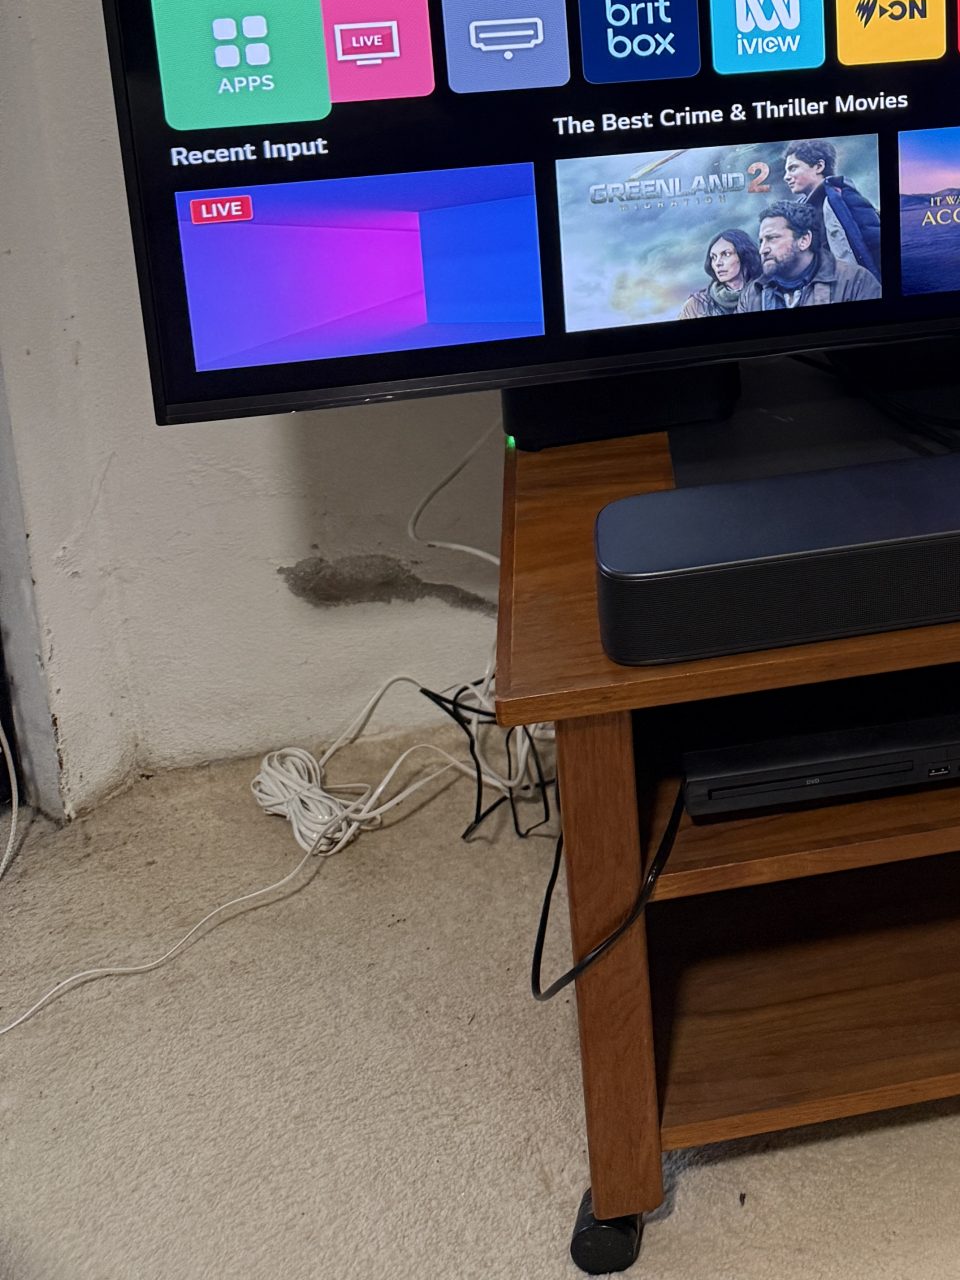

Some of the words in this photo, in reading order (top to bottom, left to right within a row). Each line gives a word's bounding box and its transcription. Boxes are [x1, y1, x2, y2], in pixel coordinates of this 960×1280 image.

[351, 33, 384, 48] LIVE
[607, 27, 677, 60] box
[217, 74, 275, 95] APPS
[554, 116, 594, 136] The
[601, 111, 653, 132] Best
[658, 104, 724, 128] Crime
[729, 103, 747, 122] &
[752, 95, 829, 120] Thriller
[834, 91, 909, 114] Movies
[170, 142, 258, 167] Recent
[263, 136, 329, 163] Input
[589, 172, 745, 204] GREENLAND
[746, 161, 772, 193] 2
[200, 200, 244, 219] LIVE
[929, 195, 943, 206] IT
